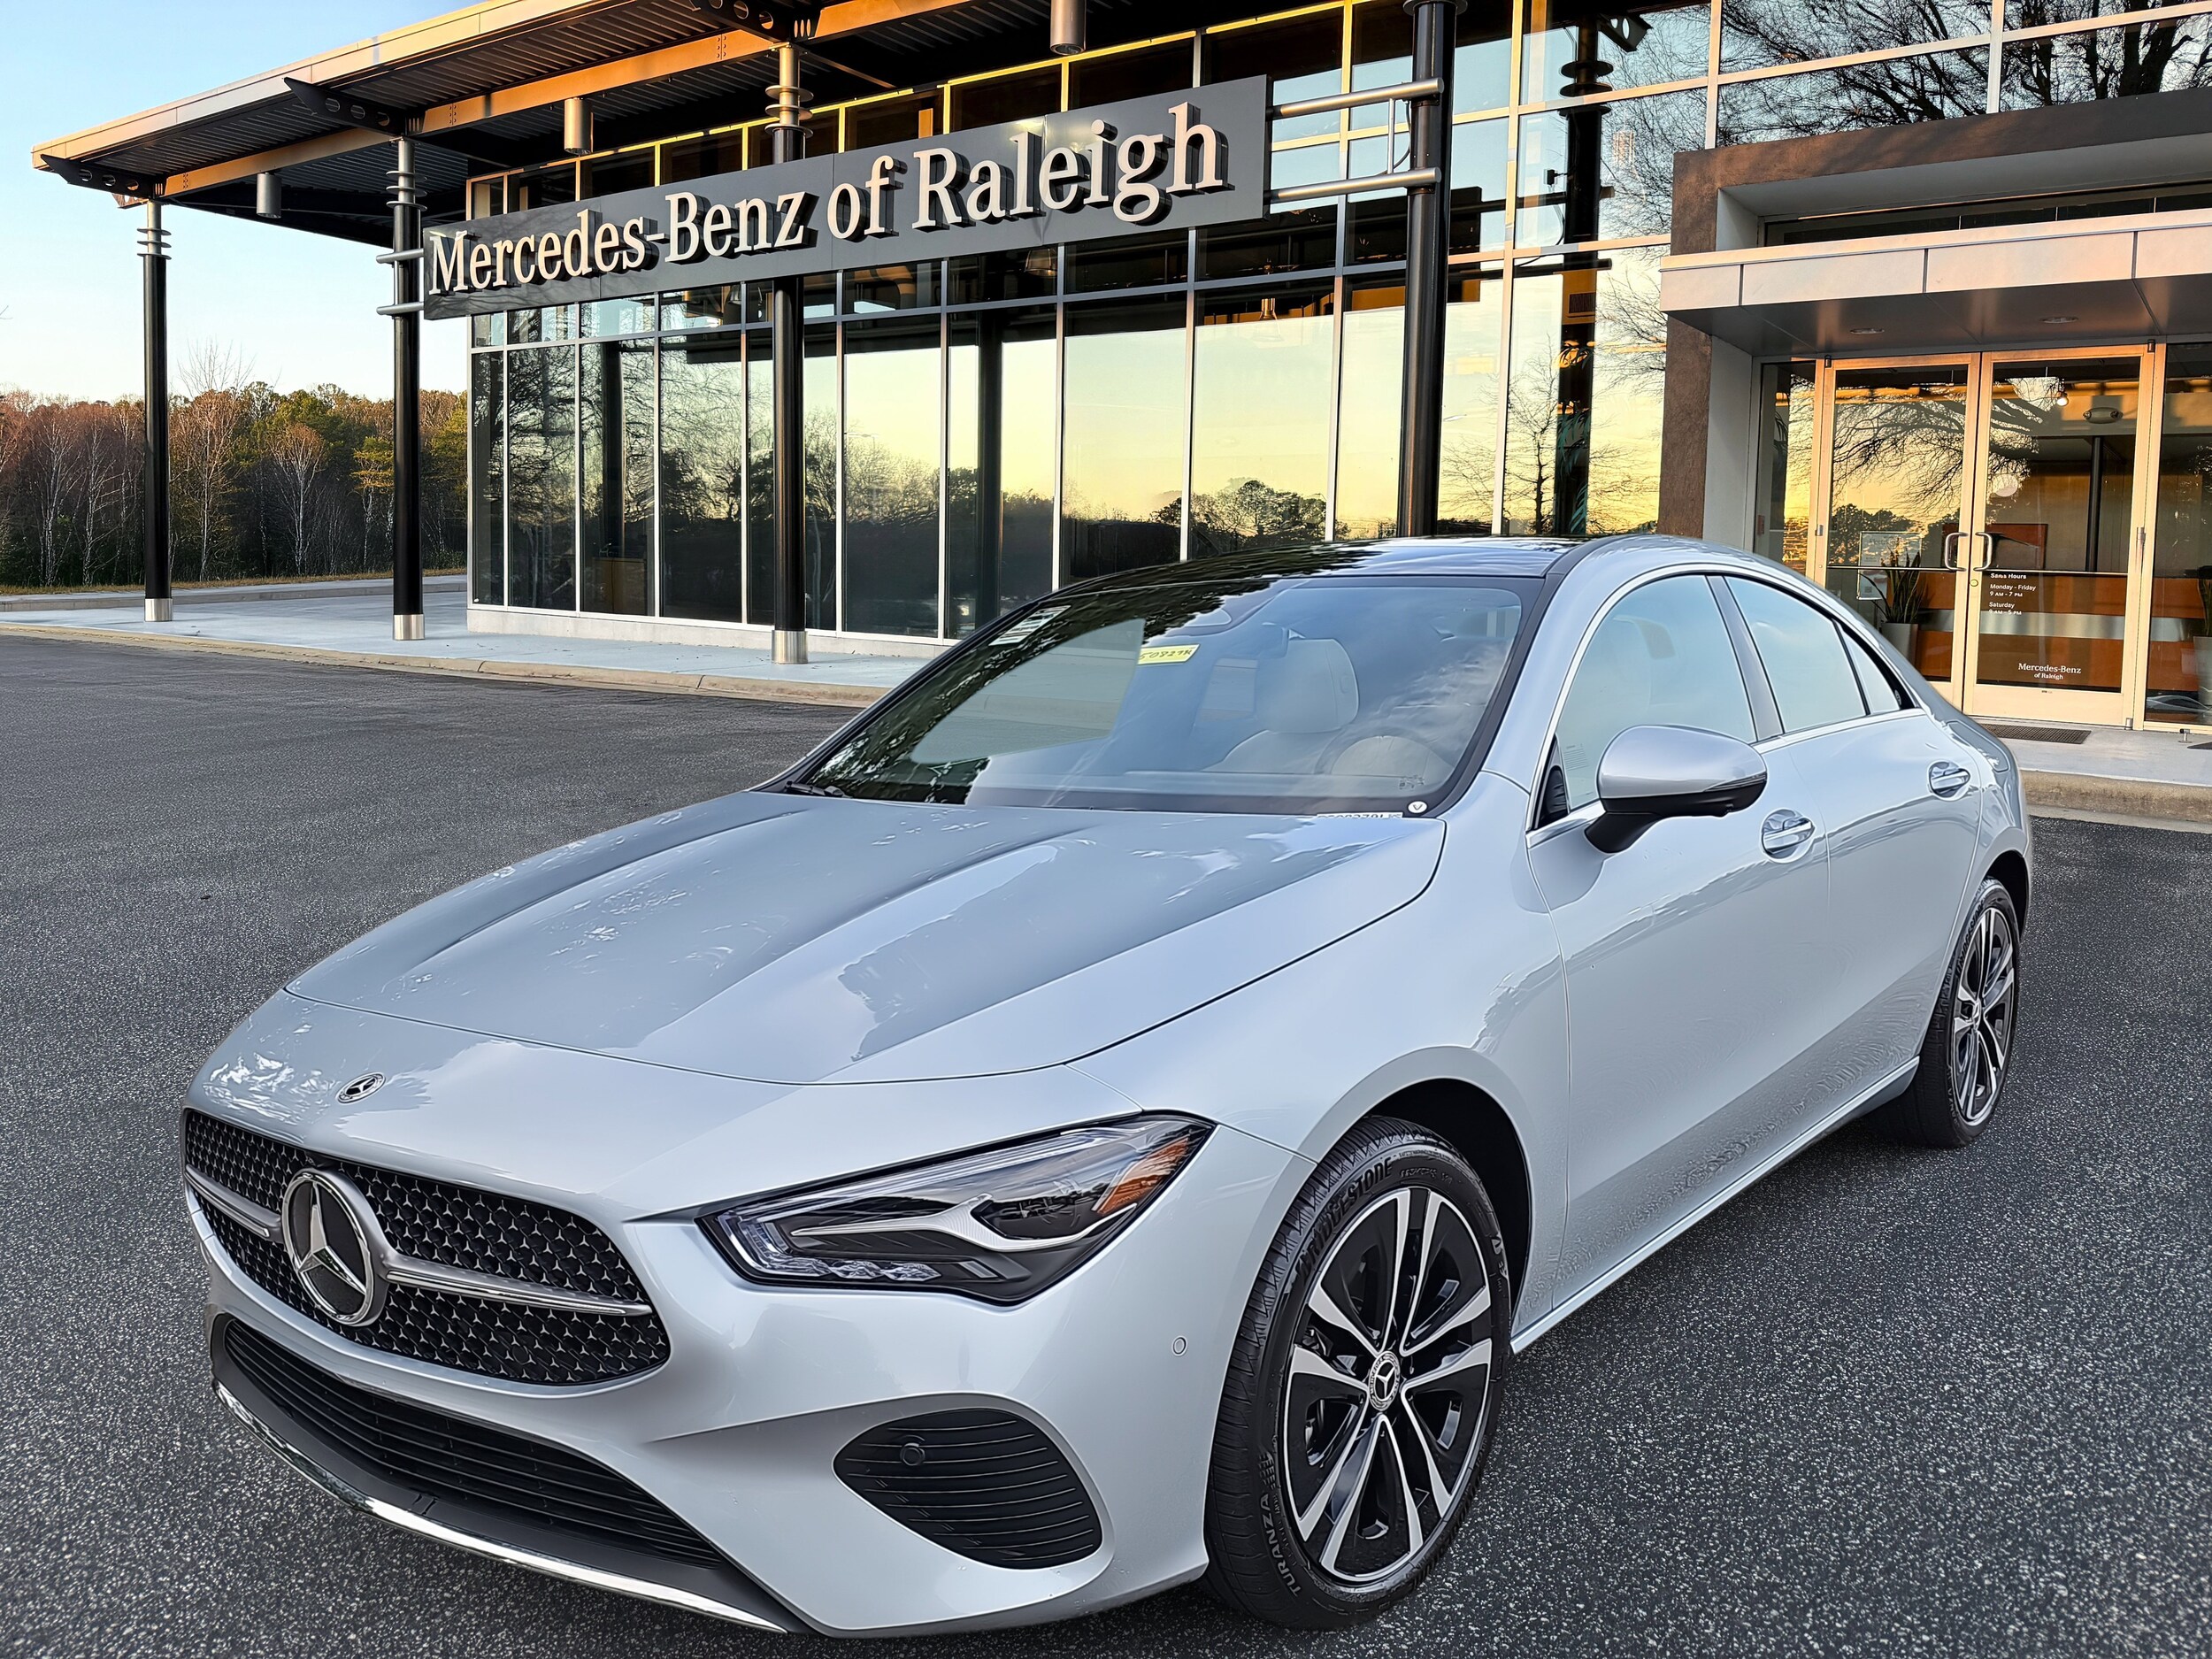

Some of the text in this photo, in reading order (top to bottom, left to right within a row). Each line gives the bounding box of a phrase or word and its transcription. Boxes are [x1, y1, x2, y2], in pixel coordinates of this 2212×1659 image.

[429, 102, 1224, 296] Mercedes-Benz of Raleigh
[2018, 663, 2082, 674] Mercedes-Benz
[1295, 1156, 1394, 1277] BRIDGESTONE
[1260, 1493, 1302, 1596] TURANZA
